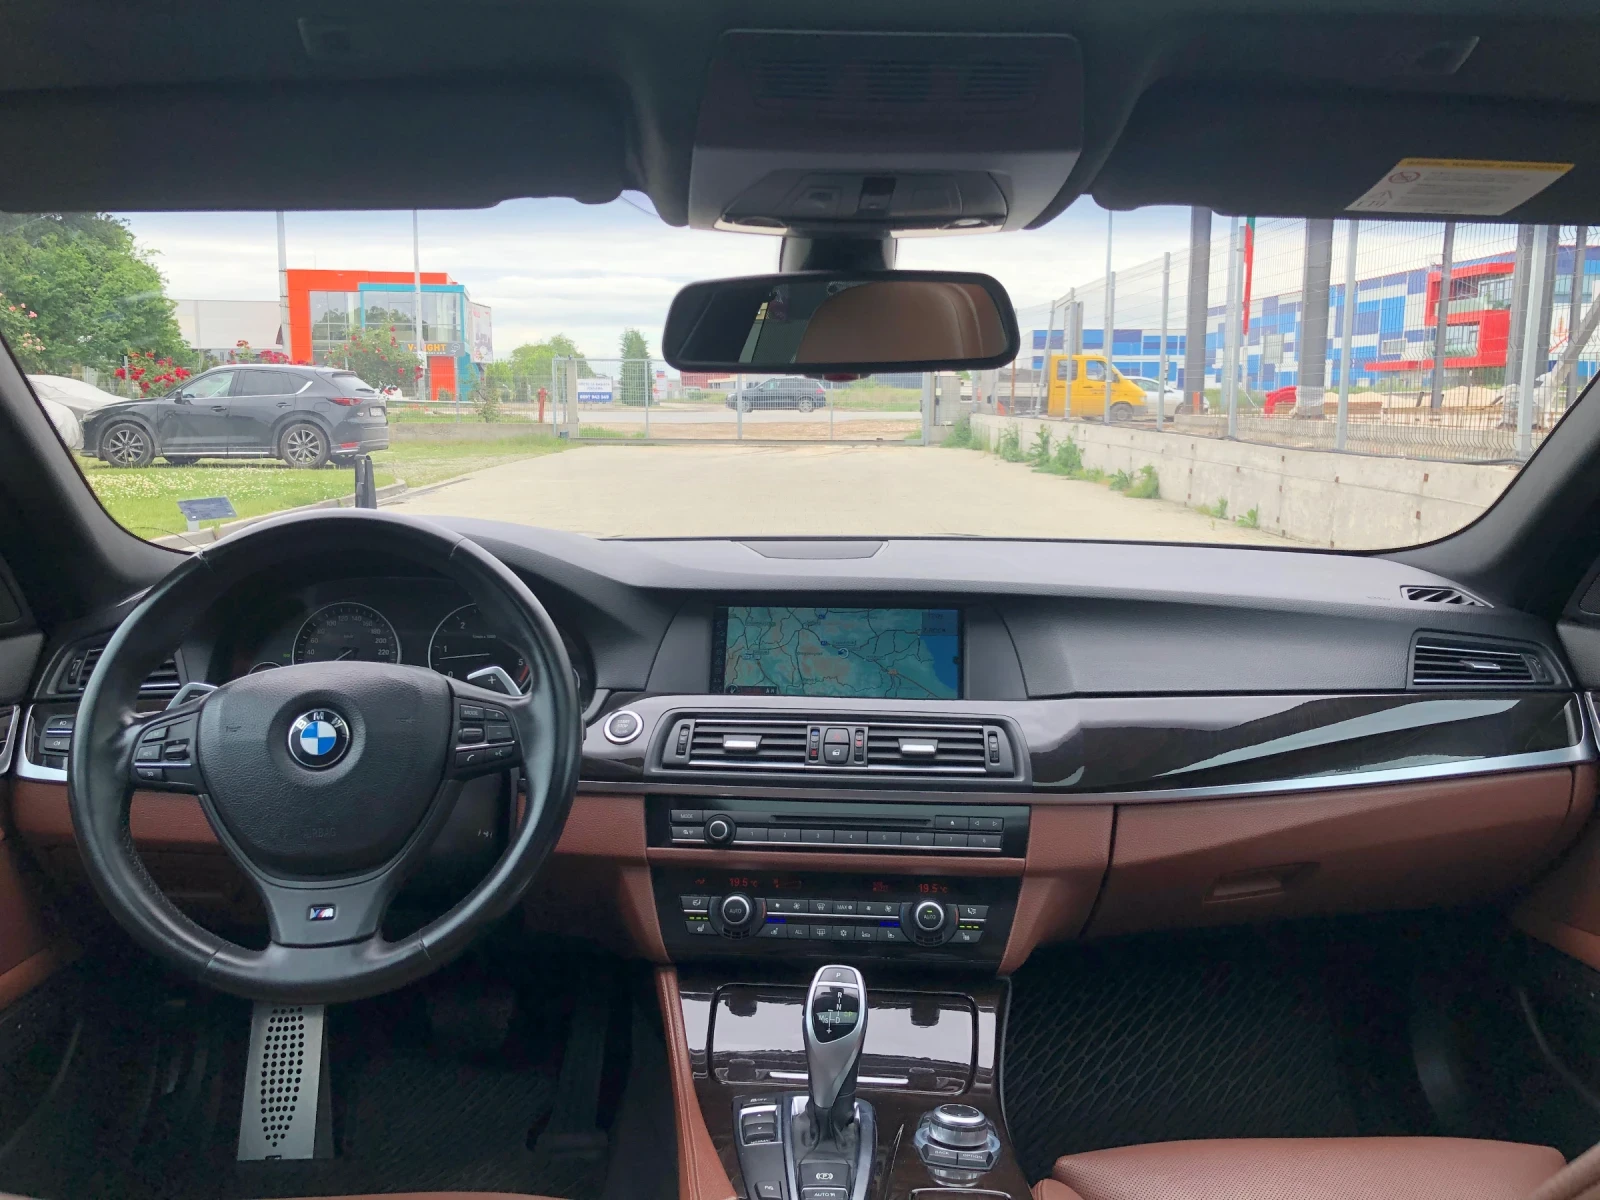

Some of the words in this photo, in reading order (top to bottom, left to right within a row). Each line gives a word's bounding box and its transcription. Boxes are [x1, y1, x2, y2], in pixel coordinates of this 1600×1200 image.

[460, 621, 466, 630] 2
[306, 648, 315, 656] 40
[378, 648, 390, 656] 220
[443, 645, 448, 653] 1
[518, 658, 524, 666] 5
[447, 670, 454, 678] 0
[294, 711, 344, 730] BMW
[919, 883, 938, 893] 19.5
[837, 991, 843, 999] R
[836, 1003, 842, 1011] N
[835, 1016, 841, 1024] D
